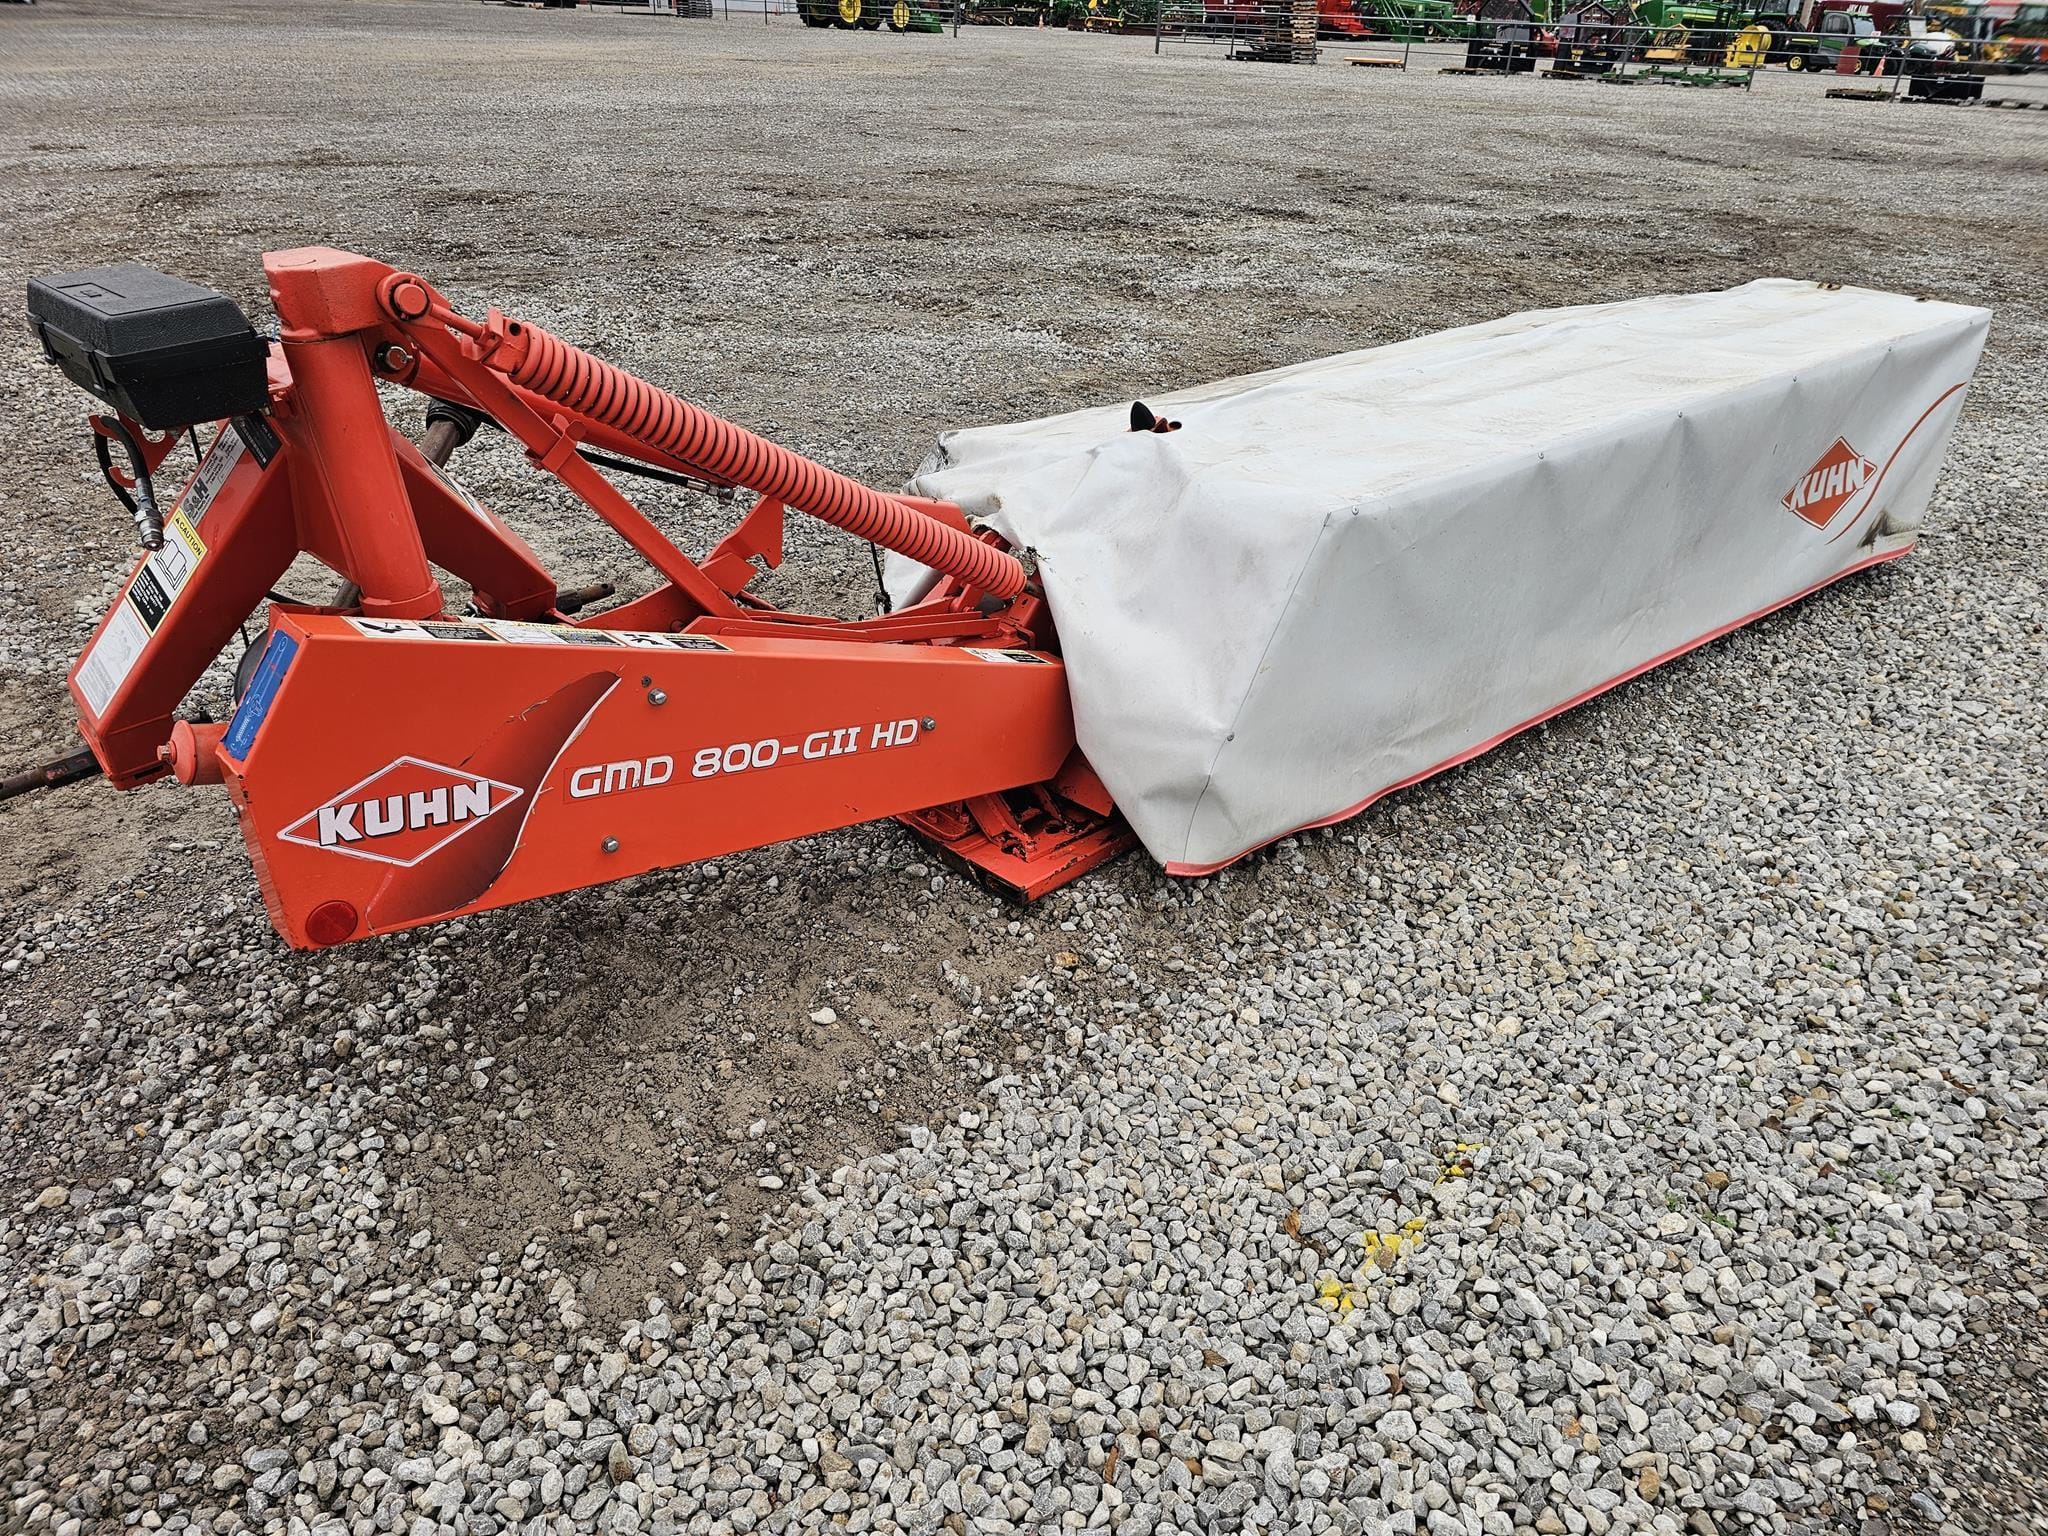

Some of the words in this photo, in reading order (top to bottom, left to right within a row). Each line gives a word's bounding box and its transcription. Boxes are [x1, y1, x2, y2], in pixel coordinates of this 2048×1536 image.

[1788, 455, 1866, 512] KUHN
[179, 522, 203, 556] CAUTION
[569, 755, 675, 799] GMD
[691, 726, 861, 779] 800-GII
[870, 718, 919, 749] HD
[317, 779, 492, 847] KUHN
